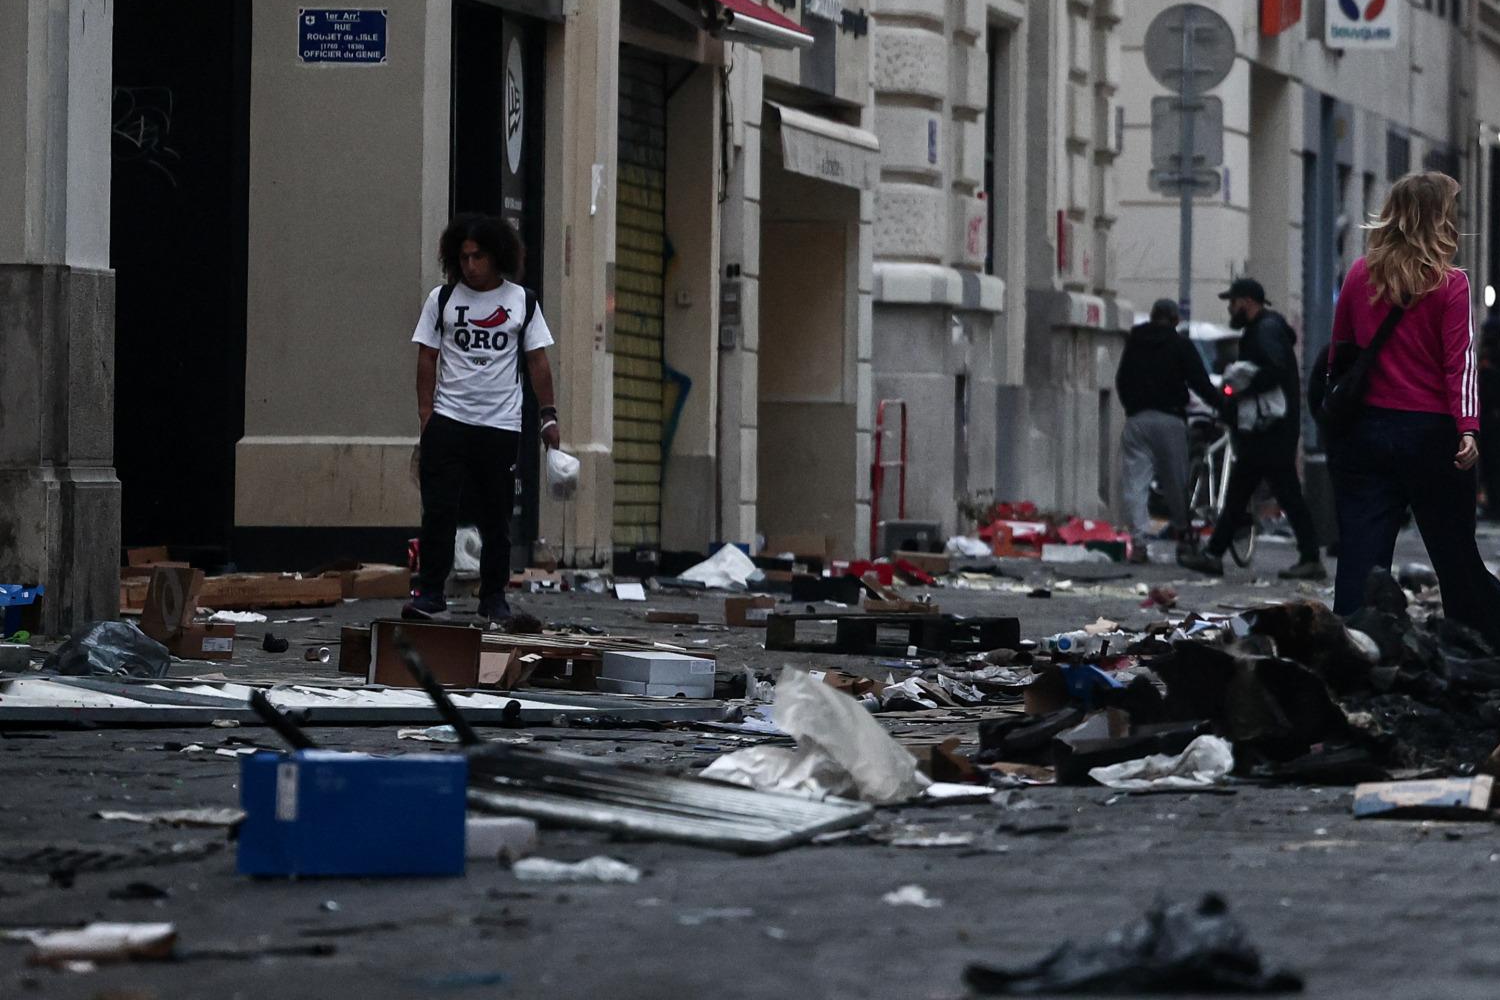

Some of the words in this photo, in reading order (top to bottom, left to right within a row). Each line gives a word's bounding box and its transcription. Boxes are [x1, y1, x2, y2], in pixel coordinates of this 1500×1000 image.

[334, 23, 351, 31] RUE
[343, 33, 353, 41] de
[303, 50, 342, 58] OFFICIER
[343, 50, 354, 58] du
[454, 306, 469, 327] I
[454, 328, 508, 352] QRO
